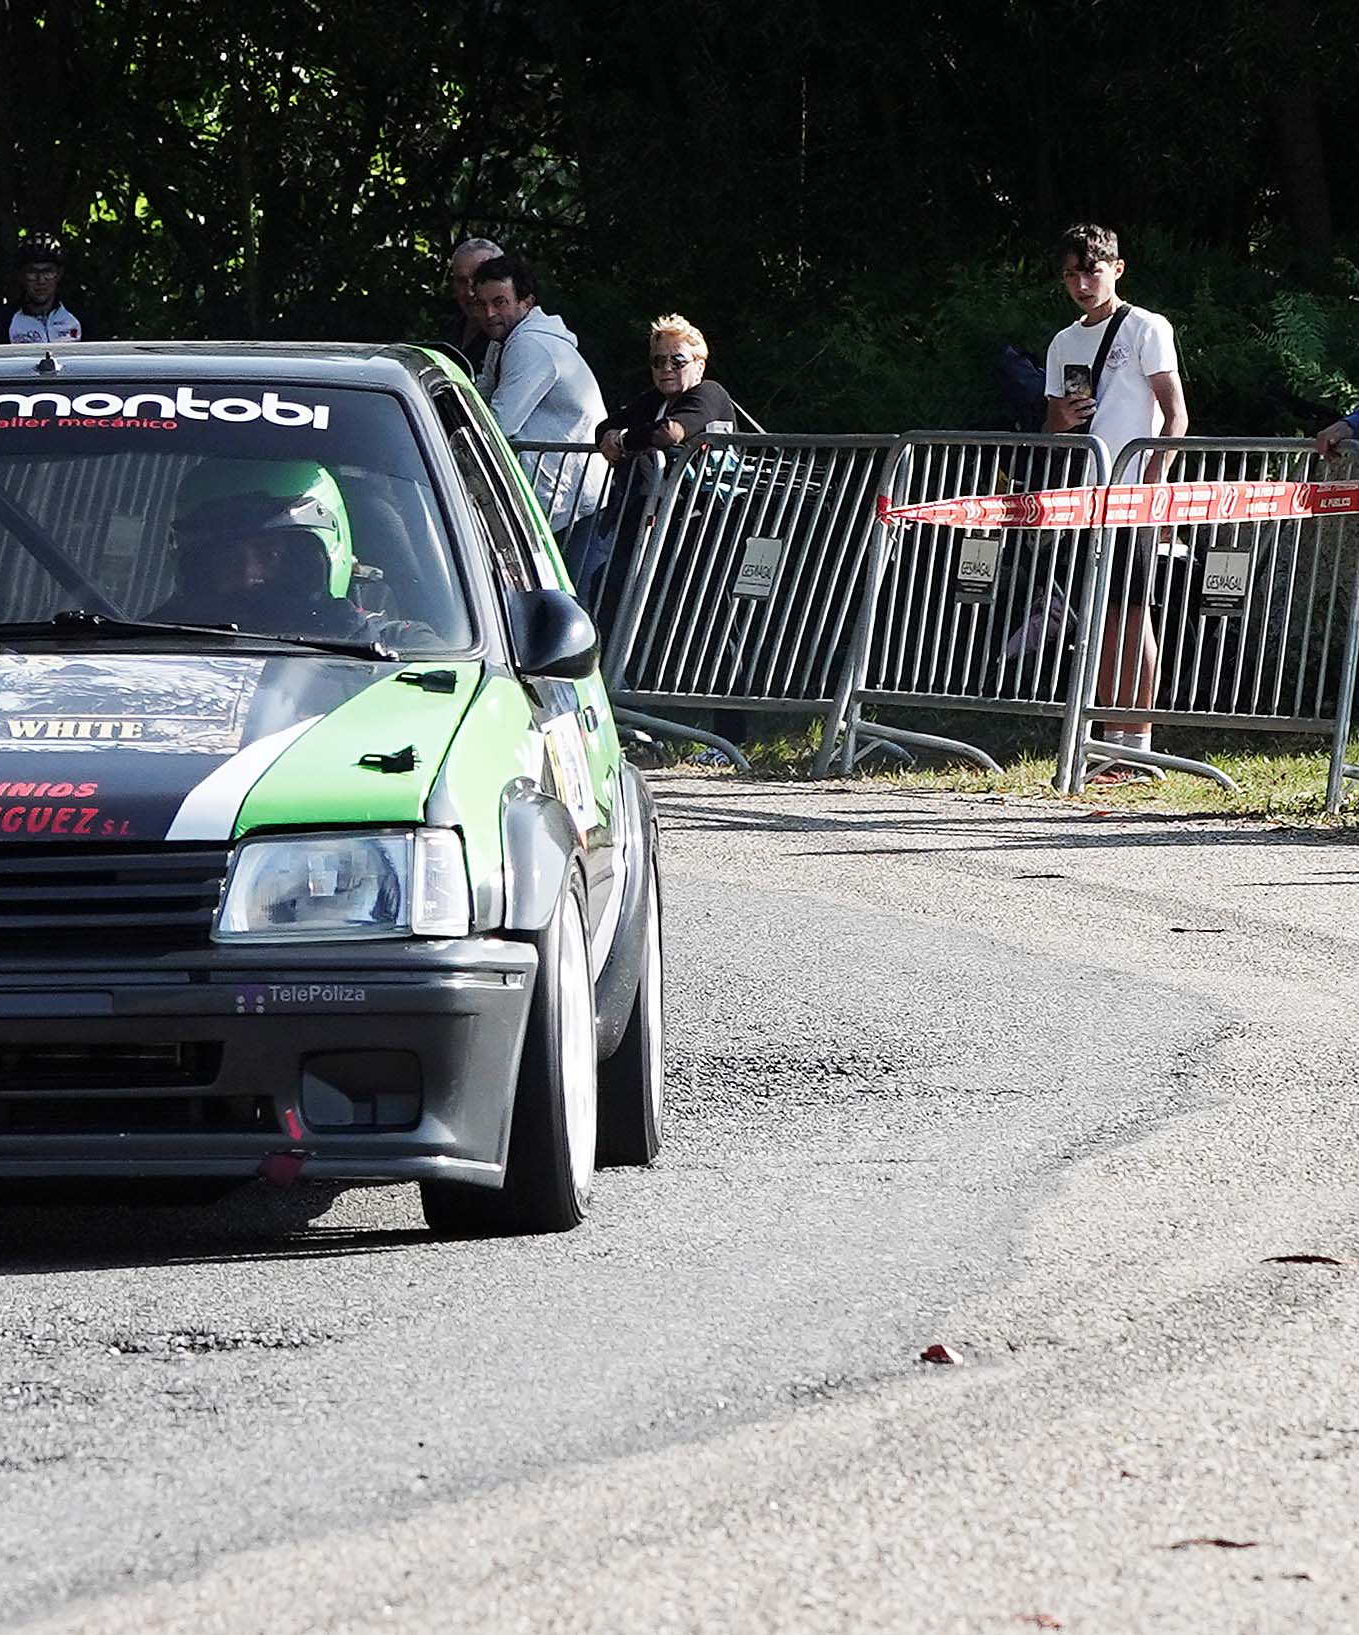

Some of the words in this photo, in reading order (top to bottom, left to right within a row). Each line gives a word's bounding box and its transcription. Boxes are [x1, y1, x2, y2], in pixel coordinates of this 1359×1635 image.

[58, 417, 178, 430] mecánico
[8, 720, 144, 739] WHITE
[269, 985, 365, 1002] TelePóliza
